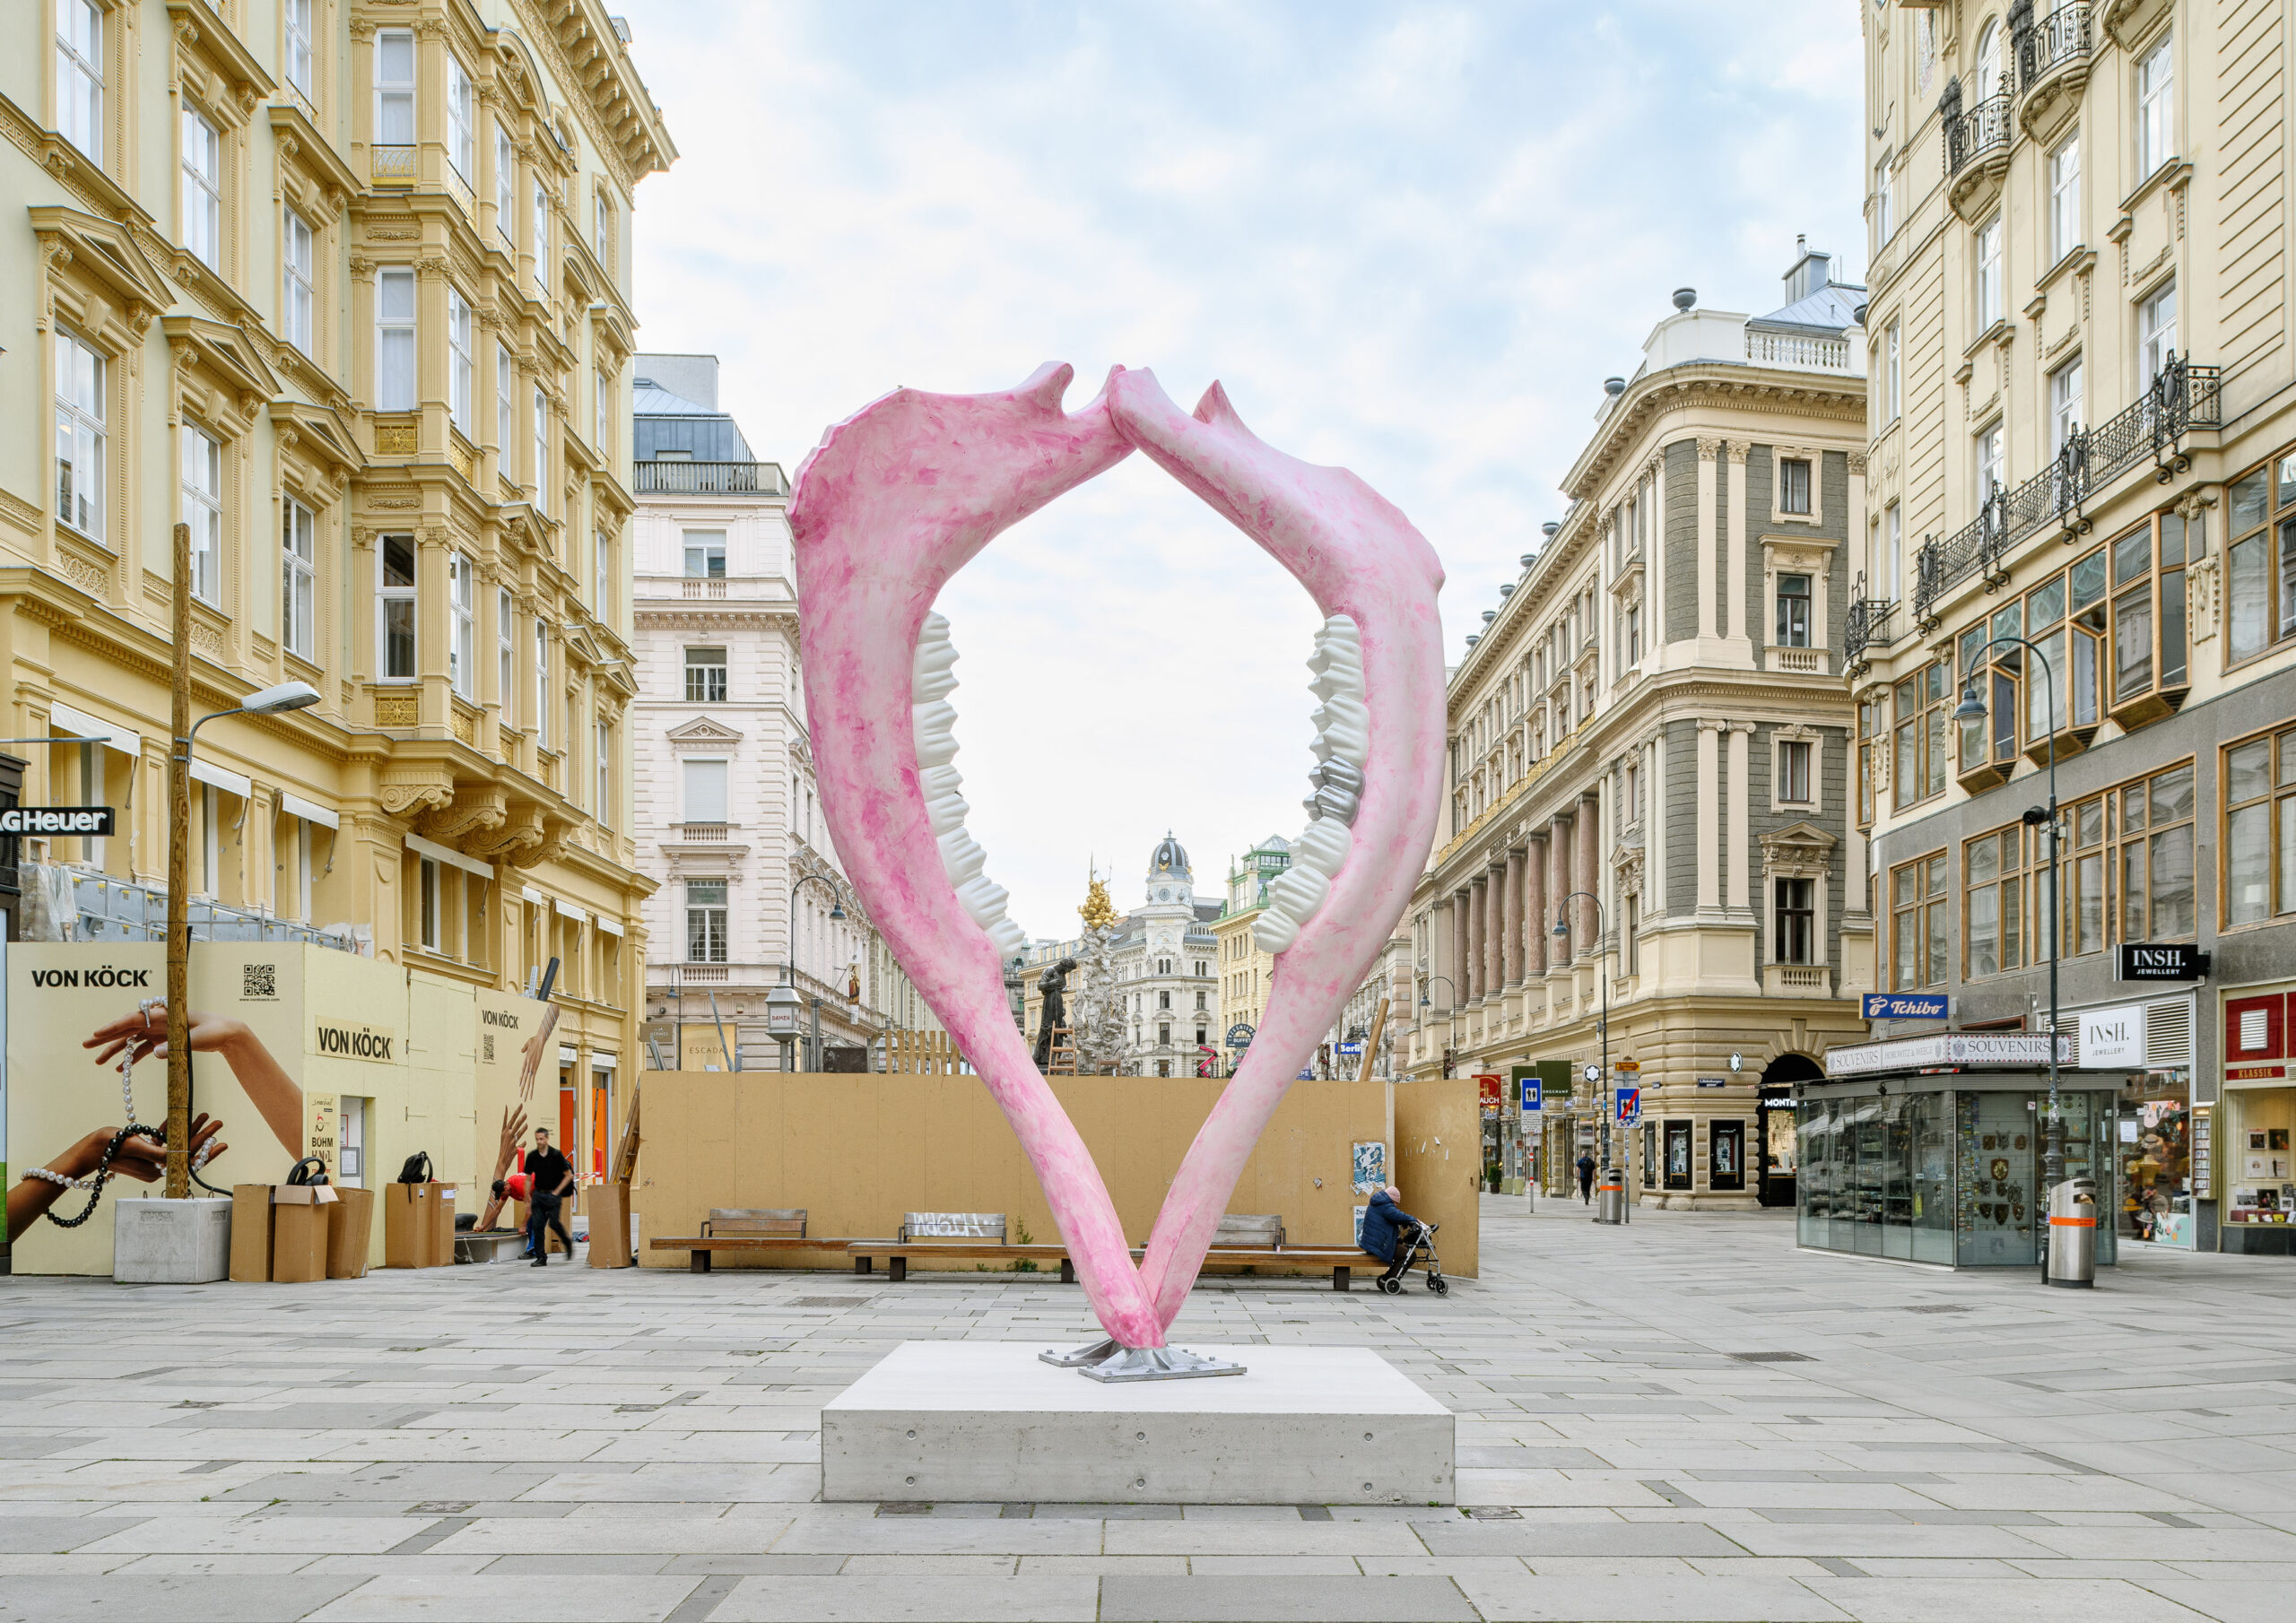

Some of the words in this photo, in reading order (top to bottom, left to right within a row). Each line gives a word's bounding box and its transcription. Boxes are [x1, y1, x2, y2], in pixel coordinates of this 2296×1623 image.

[2132, 950, 2187, 967] INSH.
[31, 970, 79, 987] VON
[83, 965, 149, 987] KÖCK
[1890, 1000, 1944, 1015] Tchibo
[482, 1010, 498, 1026] VON
[499, 1010, 519, 1030] KÖCK
[2090, 1022, 2129, 1045] INSH.
[318, 1027, 350, 1055] VON
[352, 1027, 391, 1060] KÖCK
[689, 1046, 724, 1055] ESCADA
[1968, 1040, 2051, 1054] SOUVENIRS
[2092, 1047, 2125, 1056] JEWELLERY
[1836, 1050, 1878, 1068] SOUVENIRS
[2238, 1067, 2273, 1079] KLASSIK
